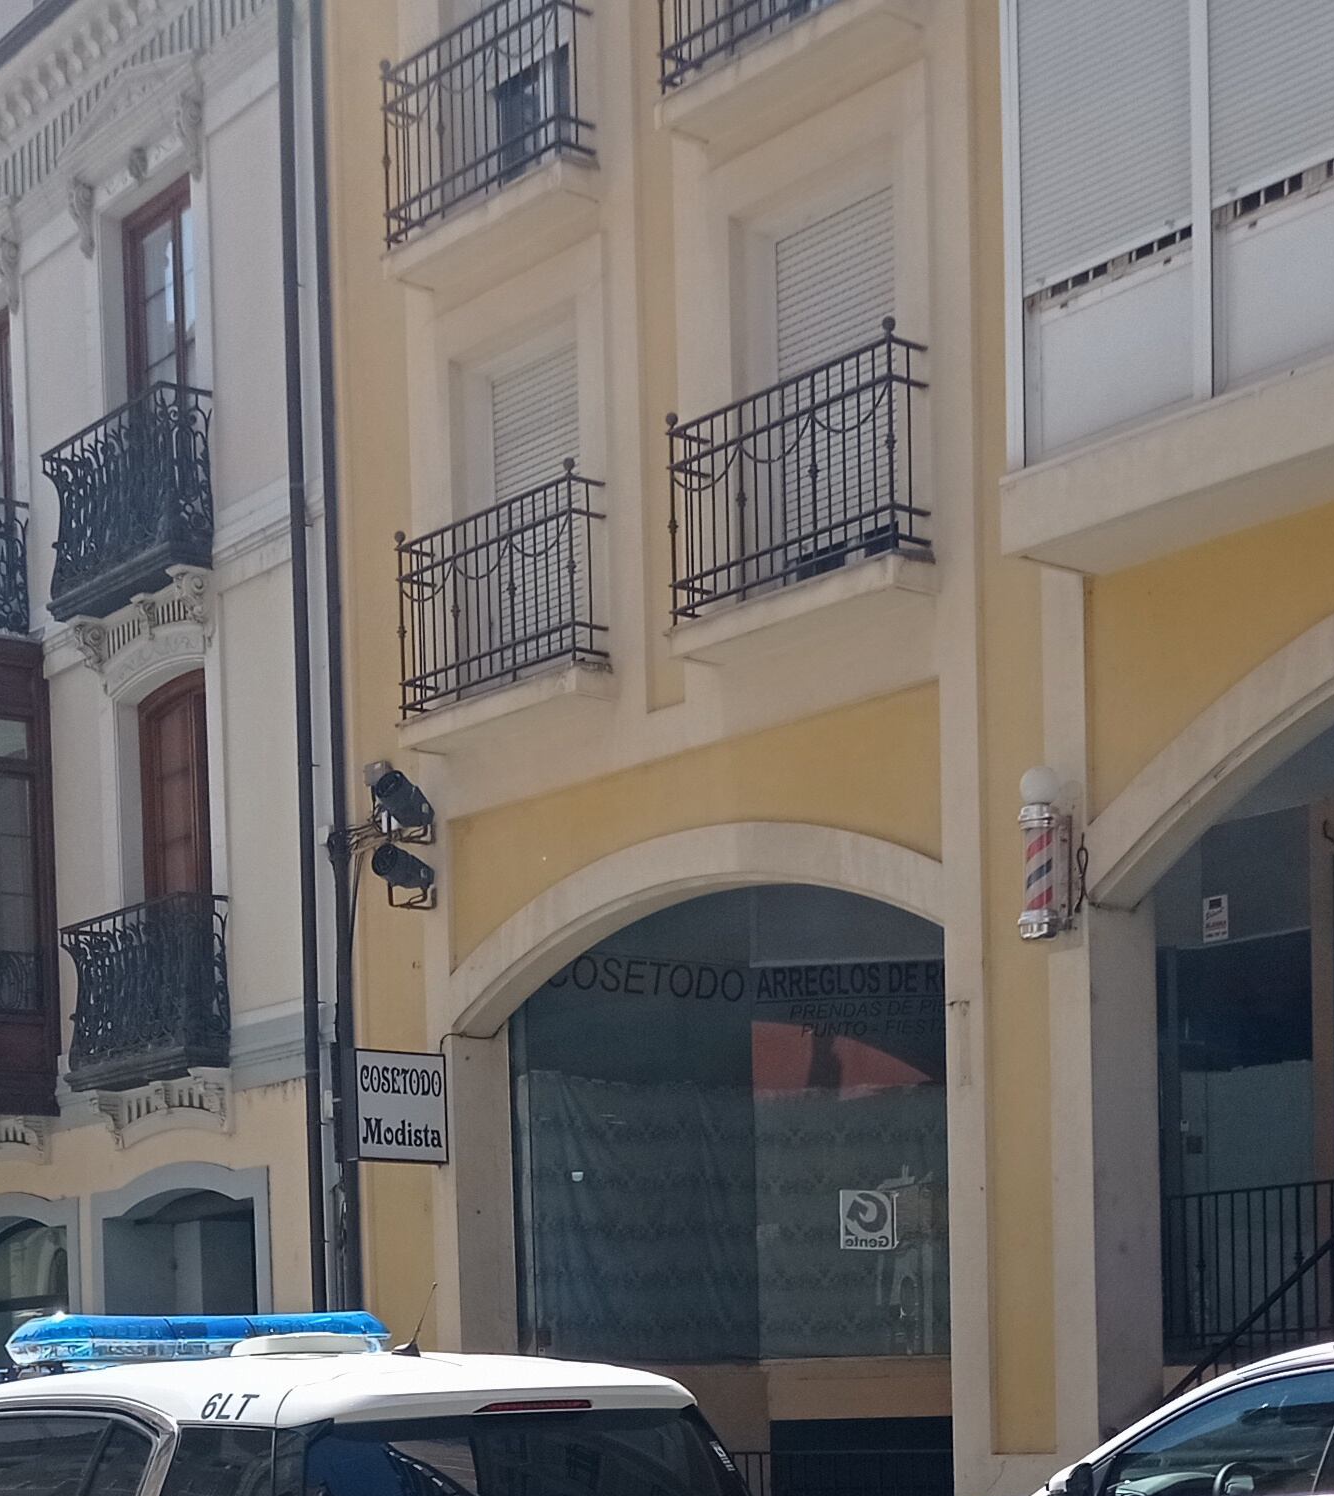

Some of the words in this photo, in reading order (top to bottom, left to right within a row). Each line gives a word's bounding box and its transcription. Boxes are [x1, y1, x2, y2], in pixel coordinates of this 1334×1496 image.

[757, 963, 880, 999] ARREGLOS
[888, 962, 918, 993] DE
[789, 1001, 882, 1018] PRENDAS
[888, 1000, 913, 1016] DE
[801, 1021, 868, 1038] PUNTO
[360, 1065, 442, 1097] COSETODO
[362, 1116, 443, 1148] Modista
[199, 1393, 259, 1422] 6LT
